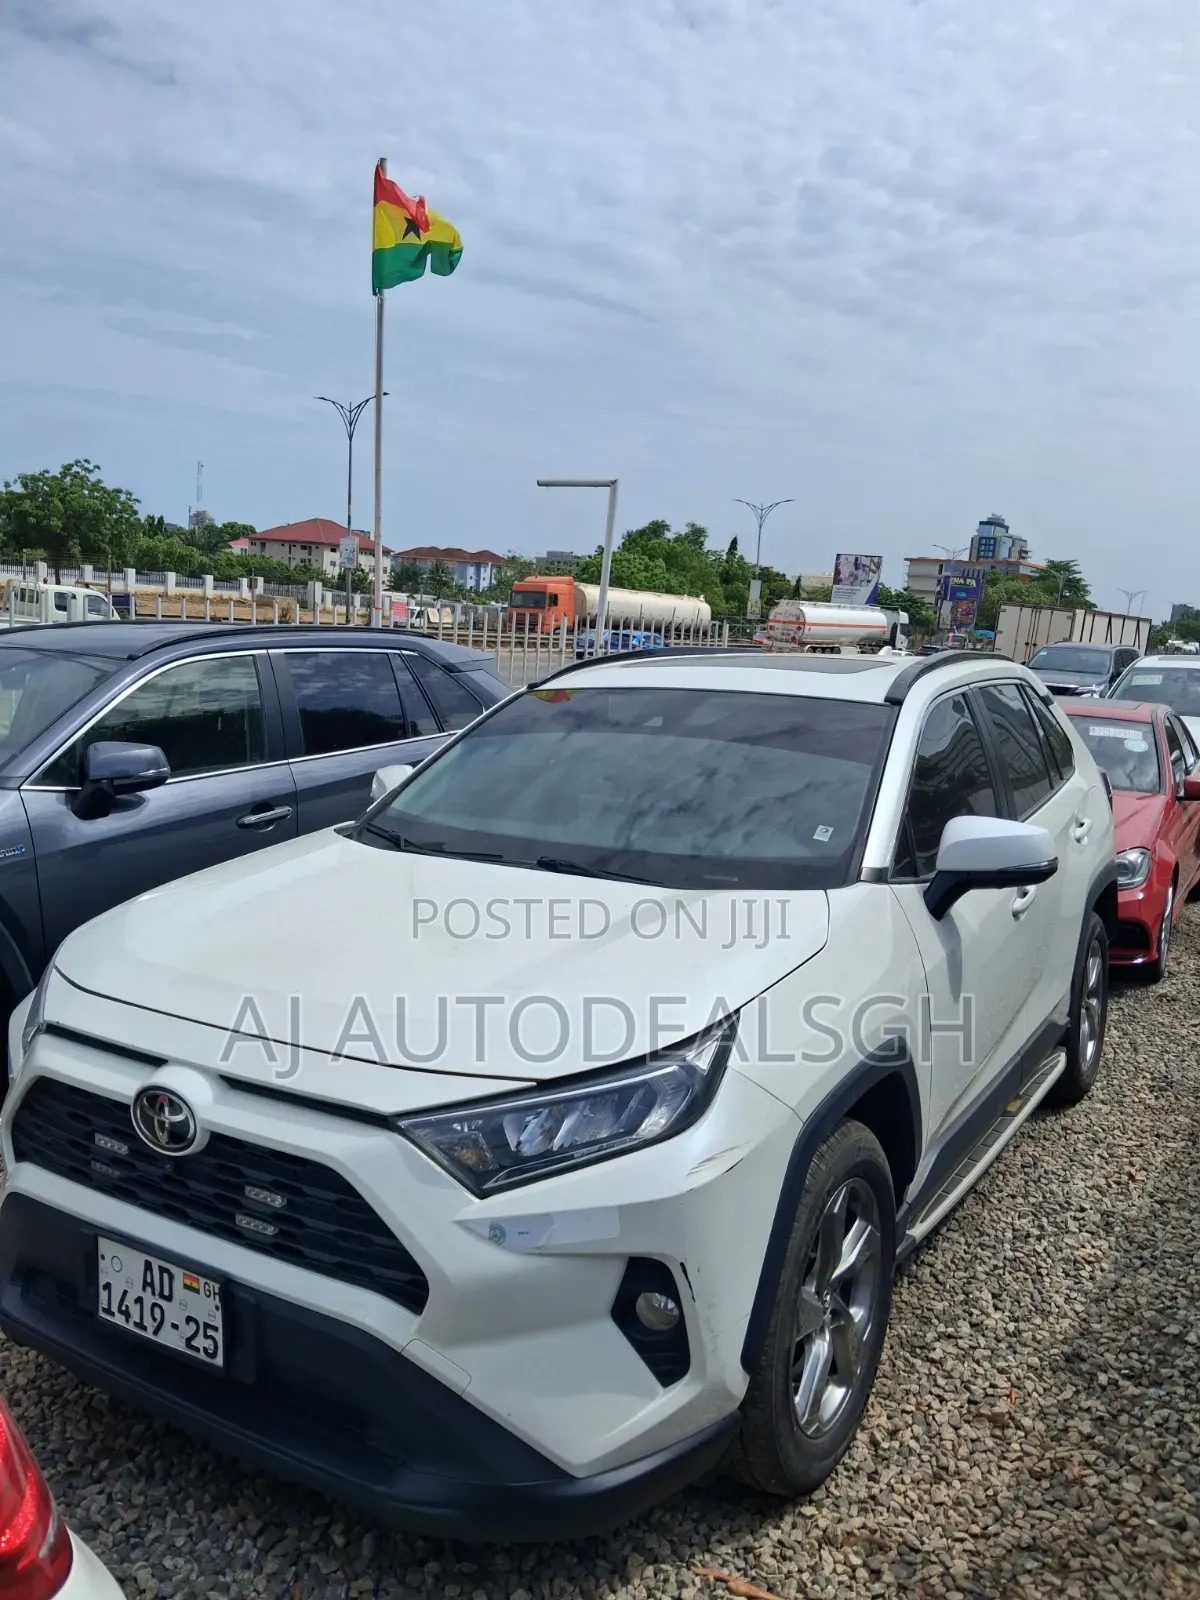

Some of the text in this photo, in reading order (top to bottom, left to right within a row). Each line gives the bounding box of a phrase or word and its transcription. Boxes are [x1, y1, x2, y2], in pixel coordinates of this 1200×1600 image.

[142, 1259, 221, 1302] AD GH
[101, 1281, 219, 1360] 1419-25
